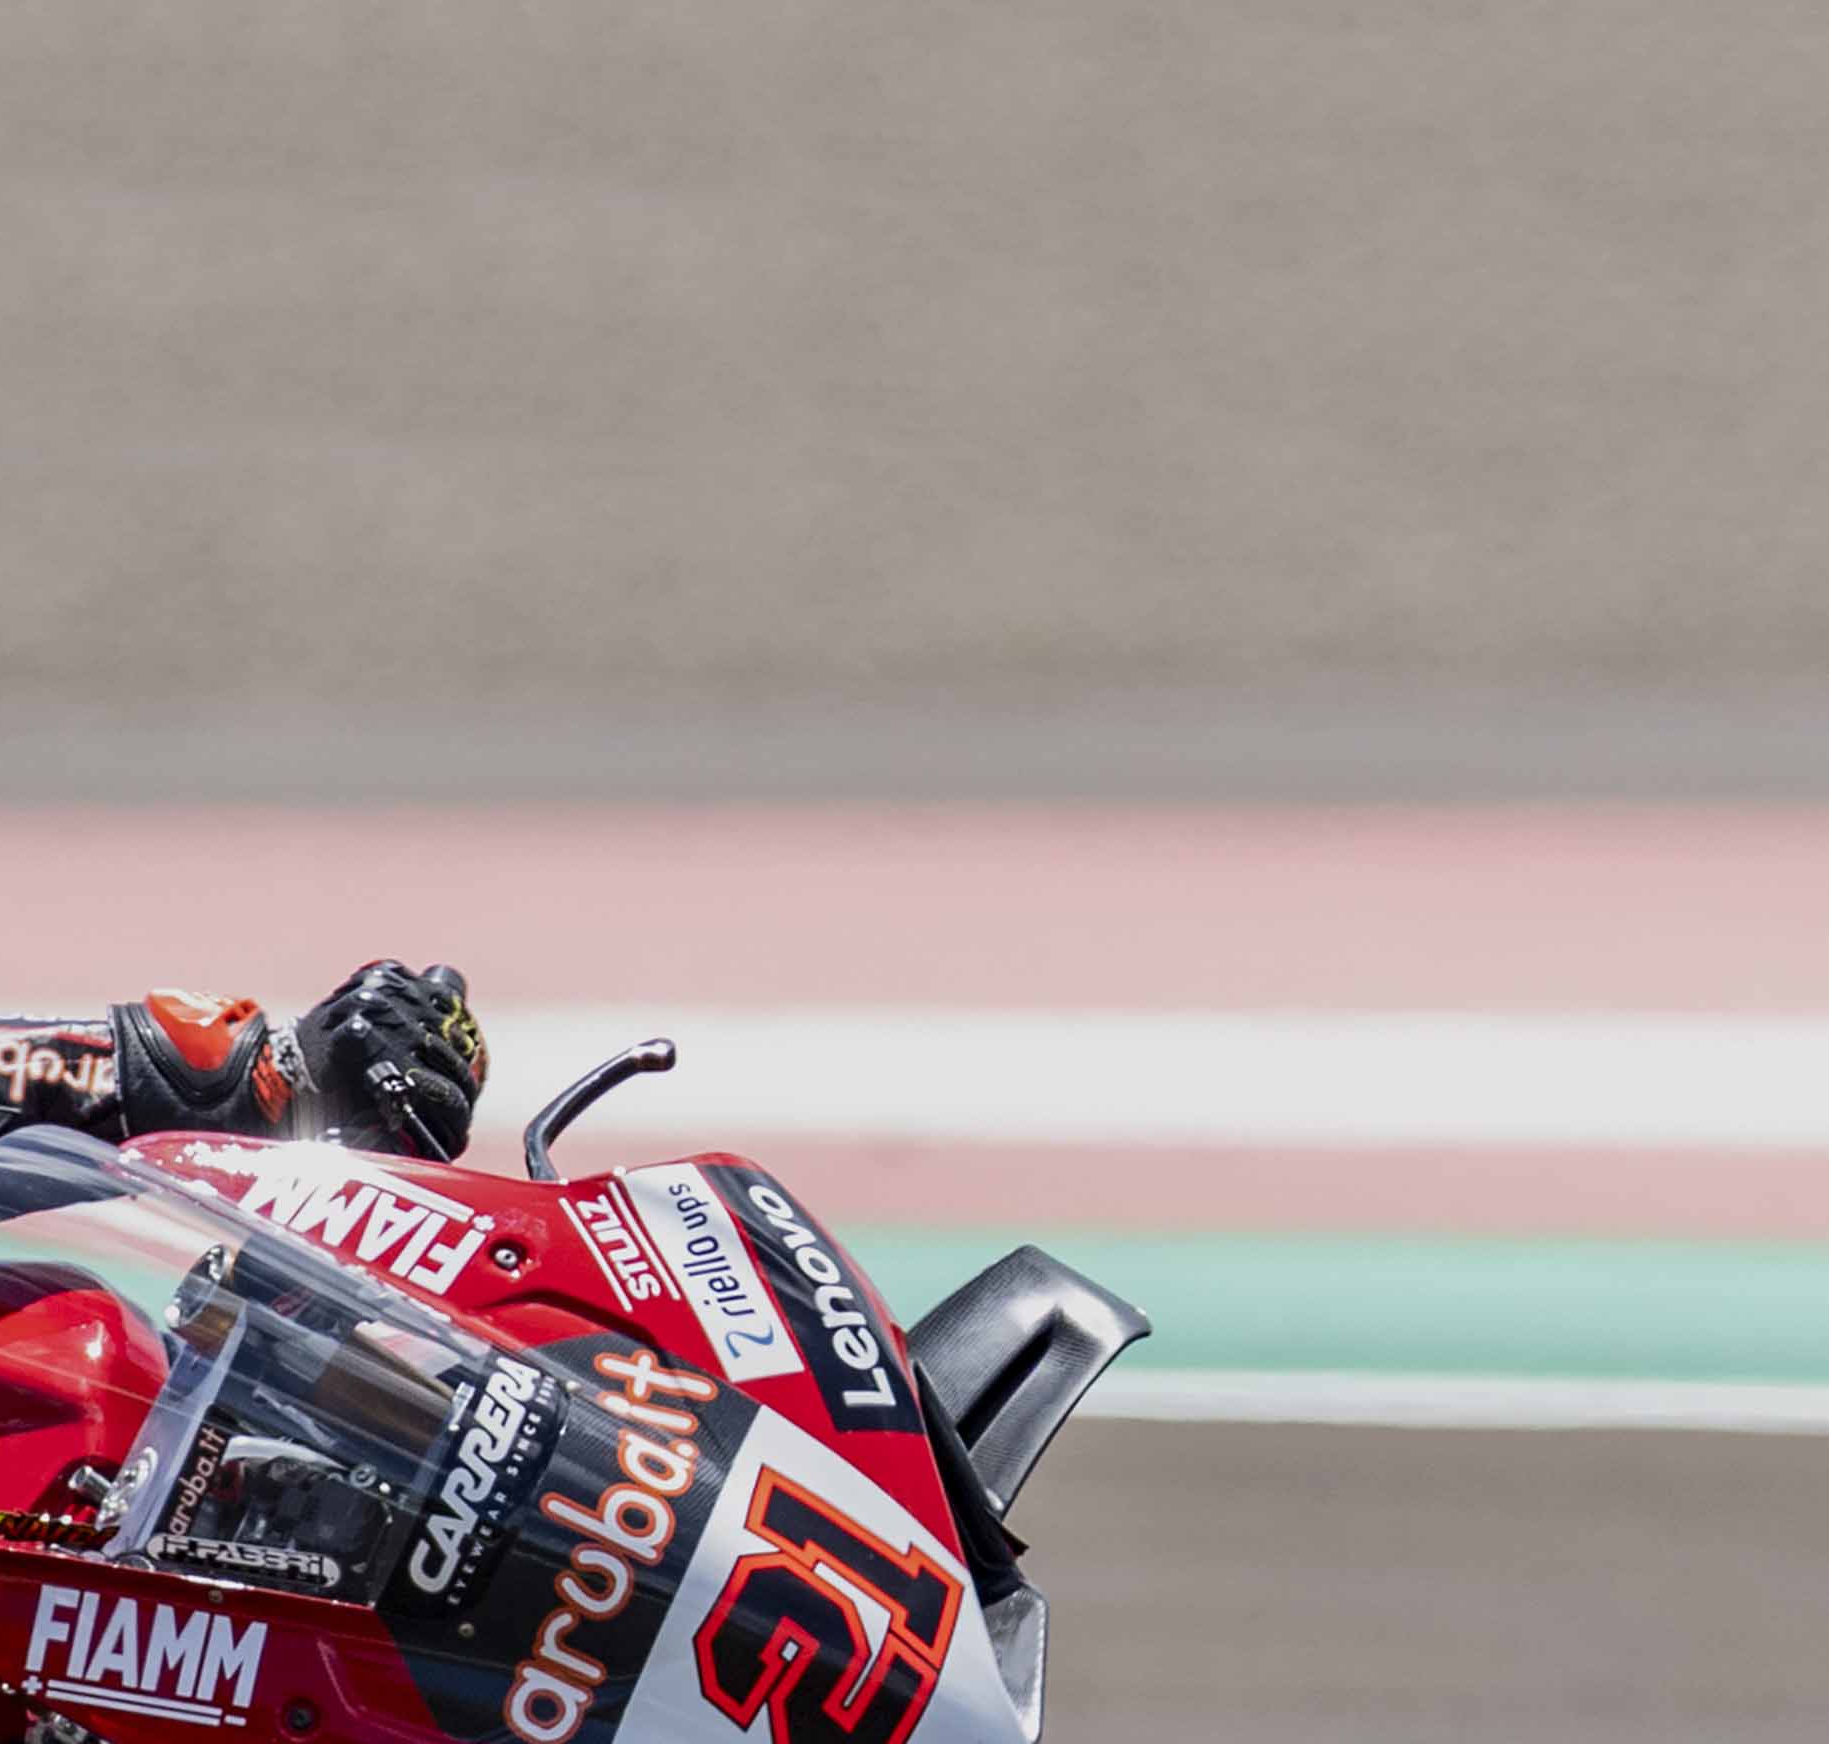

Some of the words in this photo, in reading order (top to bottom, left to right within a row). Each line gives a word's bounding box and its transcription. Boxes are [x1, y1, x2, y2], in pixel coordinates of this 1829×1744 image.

[575, 1194, 662, 1301] STULZ
[668, 1183, 710, 1231] ups
[682, 1235, 756, 1318] riello
[747, 1184, 897, 1408] Lenovo
[169, 1426, 227, 1540] aruba.it
[409, 1356, 542, 1594] CARRERA
[25, 1584, 268, 1708] FIAMM
